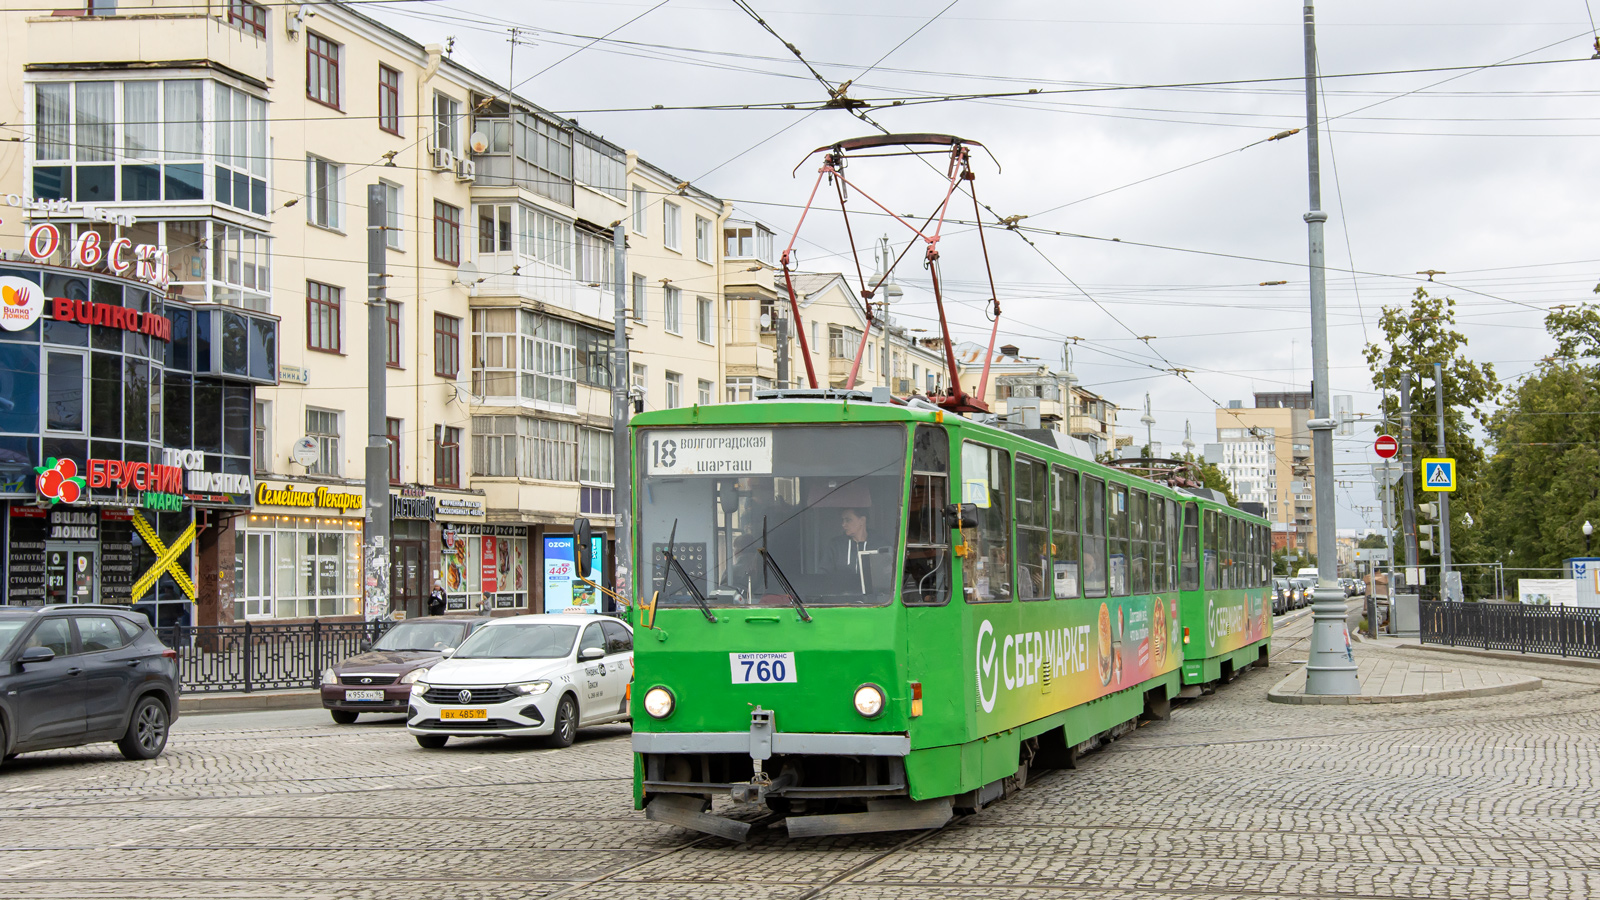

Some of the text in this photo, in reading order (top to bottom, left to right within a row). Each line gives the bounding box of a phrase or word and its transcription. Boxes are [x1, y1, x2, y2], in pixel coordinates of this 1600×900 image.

[163, 447, 204, 471] ТВОЯ
[652, 439, 677, 468] 18
[86, 458, 183, 495] БРУСНИКА
[188, 470, 252, 495] ШЛЯПКА
[144, 492, 183, 512] МАРКЕТ
[256, 482, 363, 514] Семейная Пекарня
[549, 566, 568, 575] 449
[1002, 624, 1090, 691] СБЕРМАРКЕТ
[741, 660, 786, 682] 760
[459, 710, 474, 719] 485
